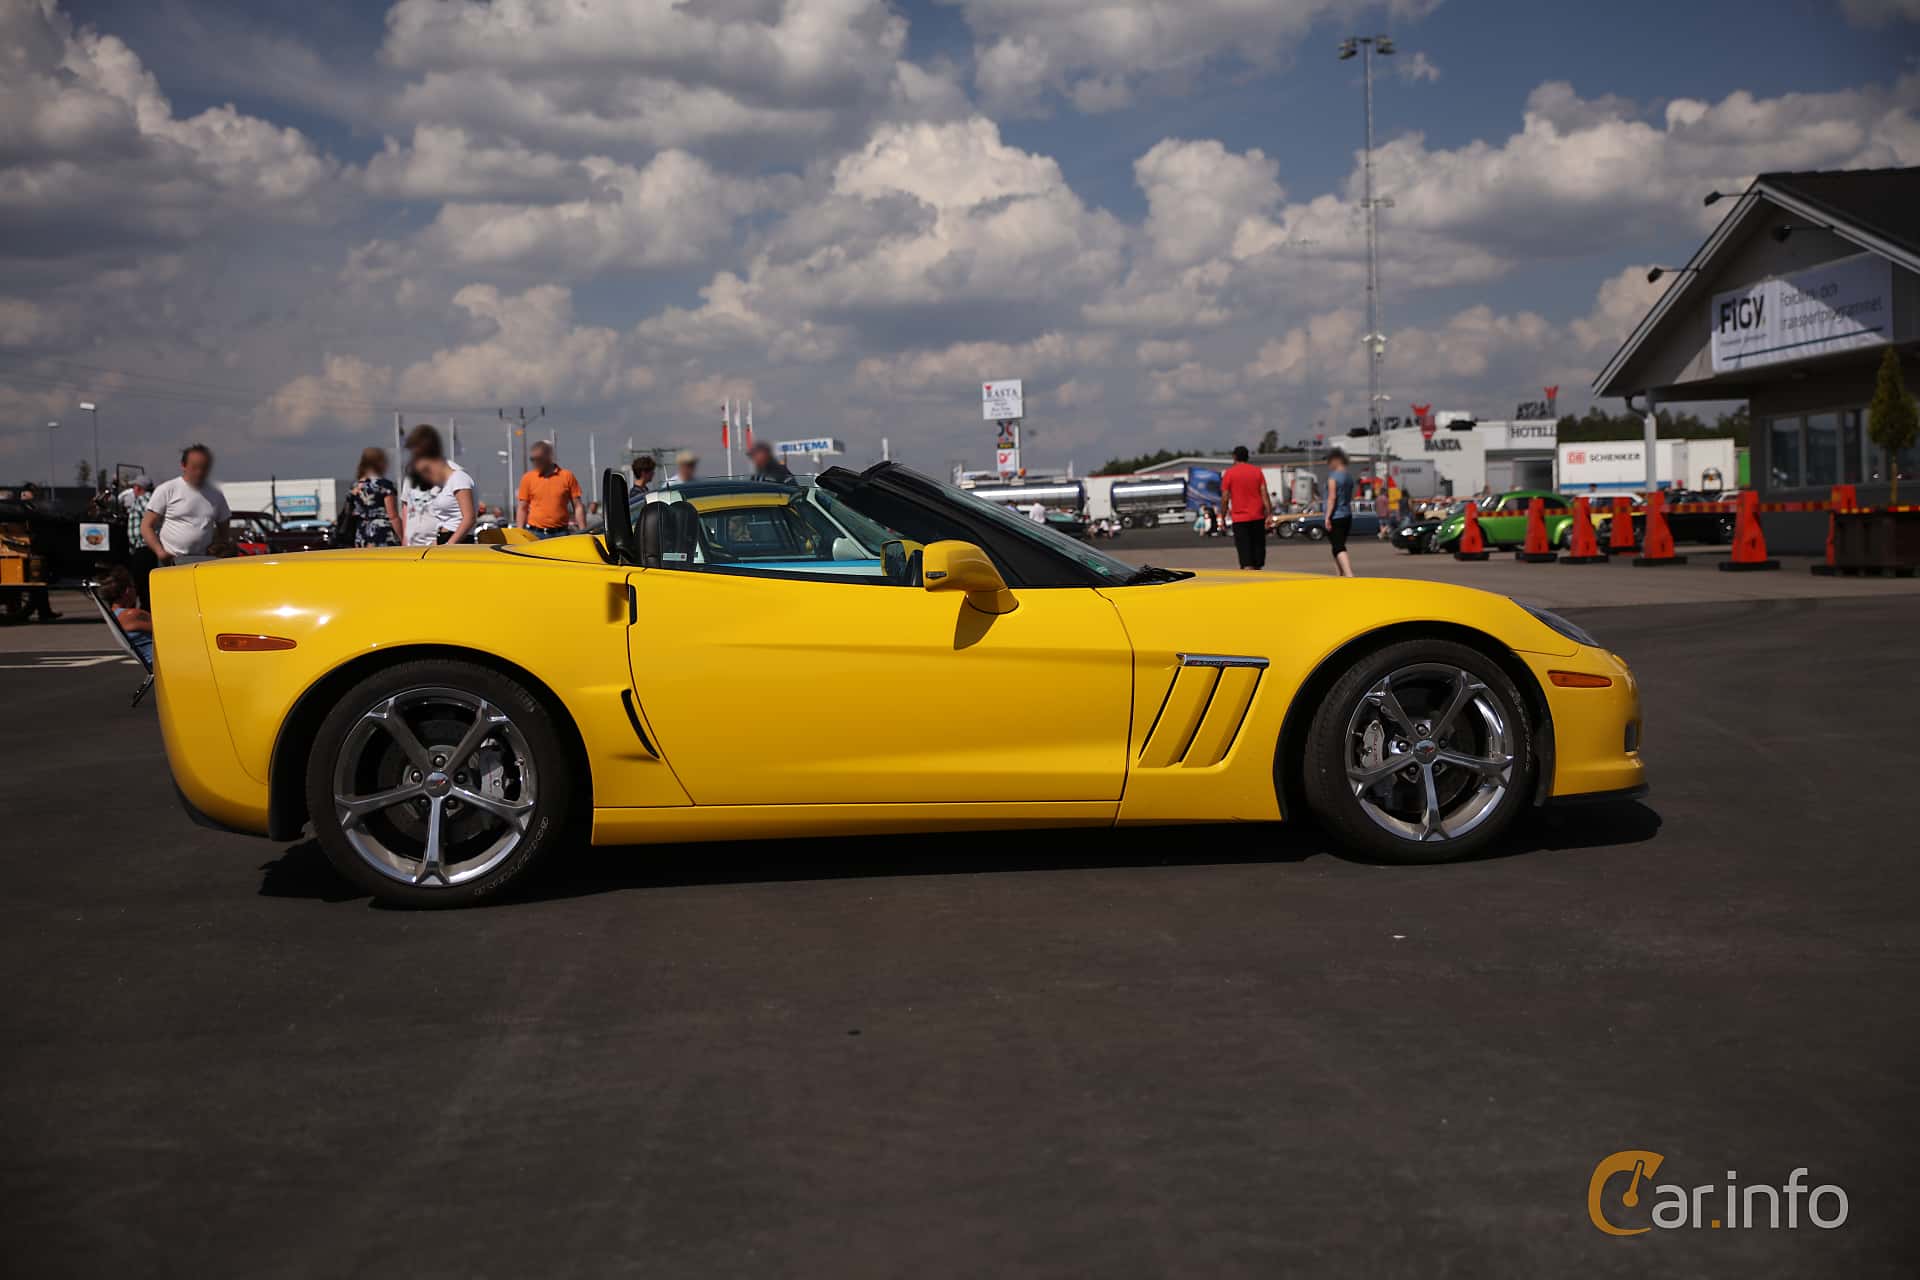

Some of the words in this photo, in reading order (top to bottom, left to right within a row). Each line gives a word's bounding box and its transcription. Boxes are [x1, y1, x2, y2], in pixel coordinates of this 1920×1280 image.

[1511, 426, 1557, 439] HOTELL
[782, 440, 829, 451] BILTEMA
[1590, 453, 1640, 463] SCHENKER
